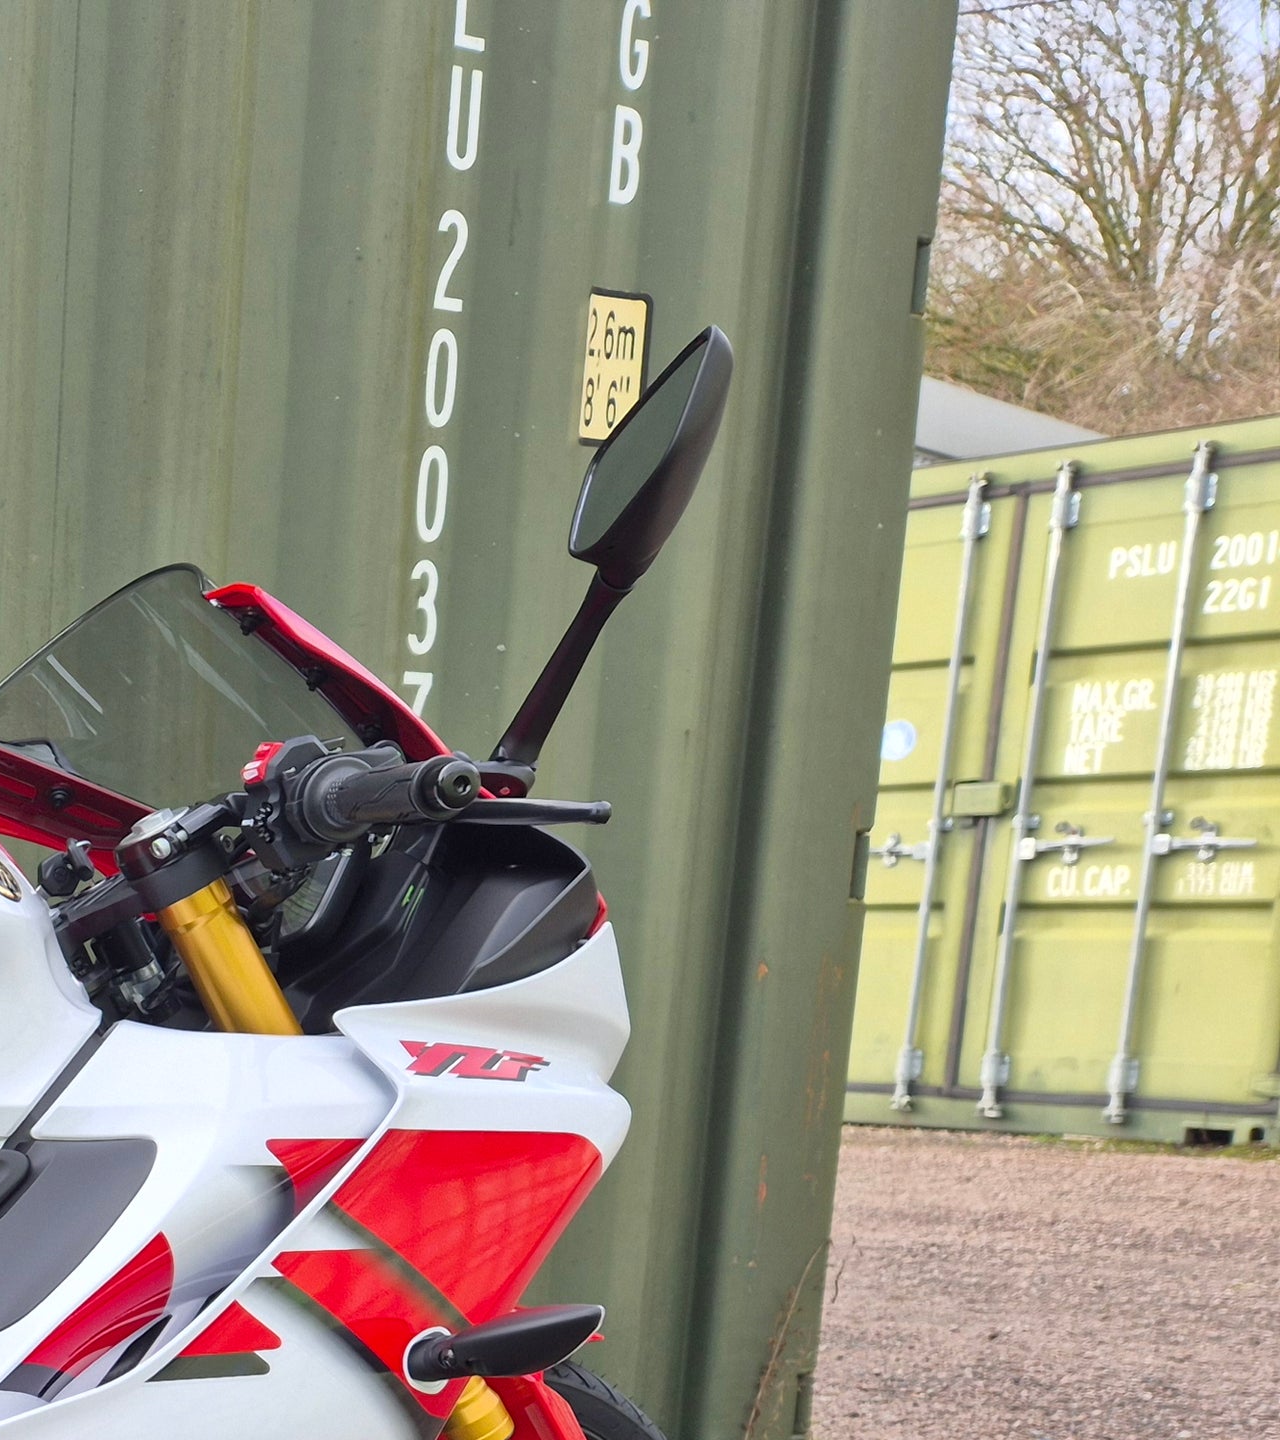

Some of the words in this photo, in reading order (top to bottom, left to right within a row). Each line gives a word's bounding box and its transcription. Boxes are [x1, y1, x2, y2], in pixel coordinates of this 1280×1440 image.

[608, 0, 652, 205] GB
[1108, 540, 1178, 580] PSLU
[1209, 529, 1280, 571] 2001
[1202, 575, 1272, 615] 22G1
[1070, 709, 1127, 743] TARE
[1063, 741, 1107, 775] NET
